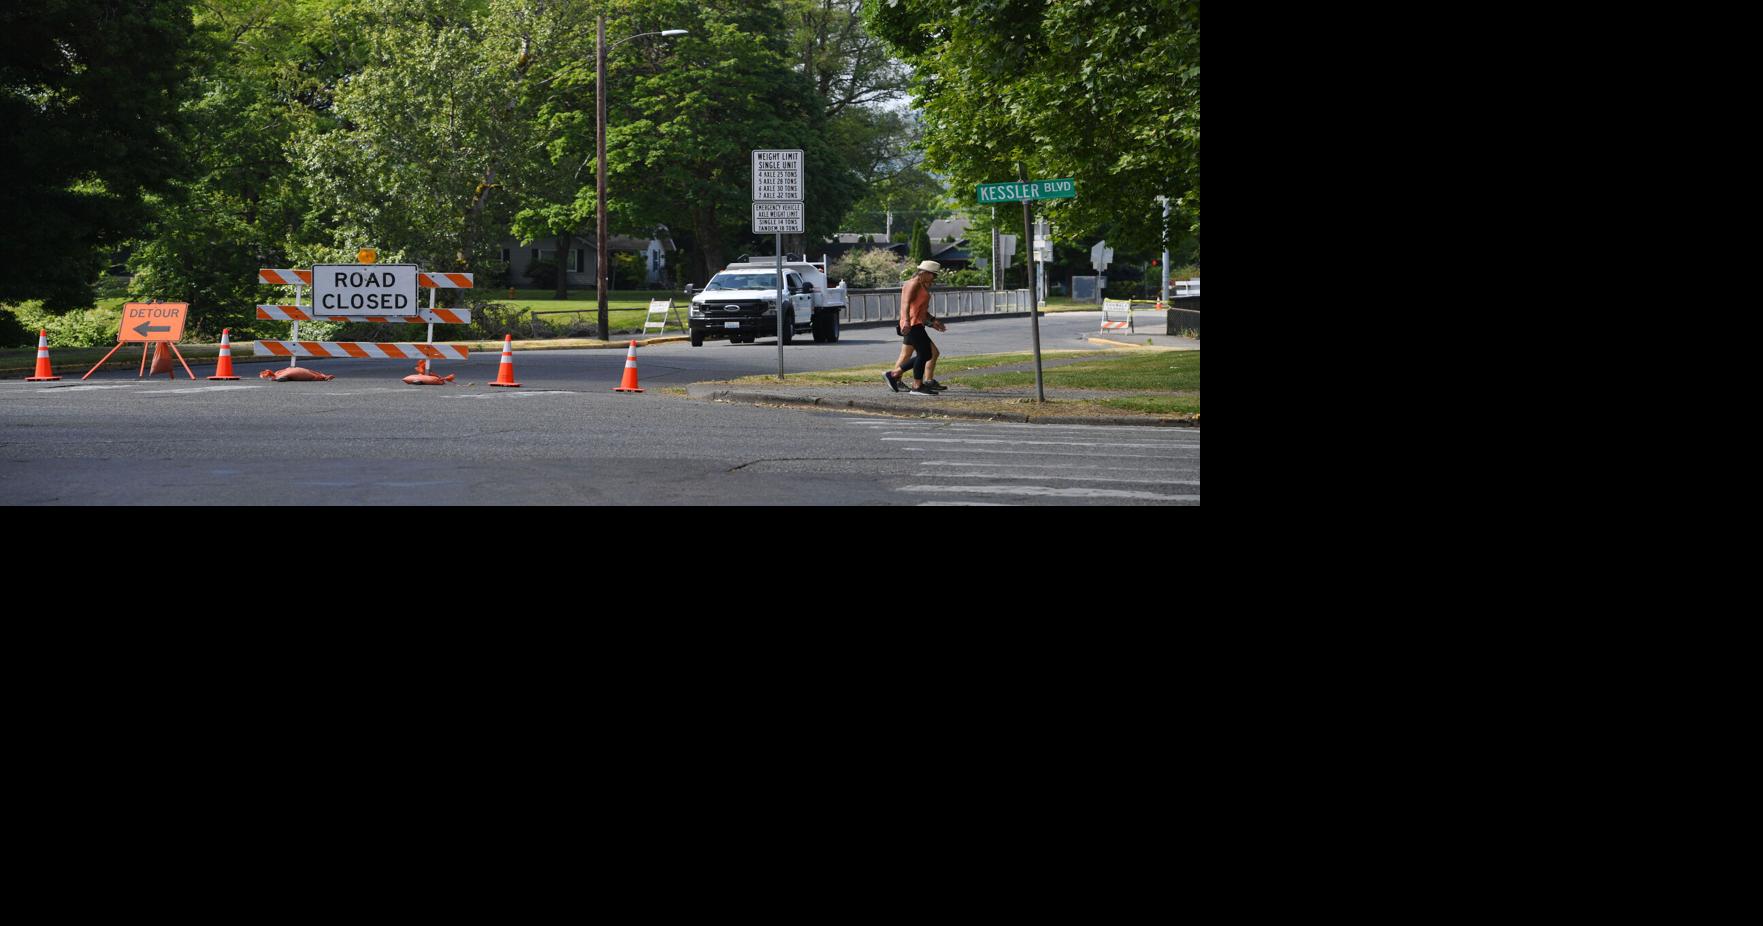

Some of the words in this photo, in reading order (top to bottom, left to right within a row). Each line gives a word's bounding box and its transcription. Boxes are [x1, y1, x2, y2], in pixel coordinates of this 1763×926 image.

[759, 161, 780, 169] SINGLE
[783, 161, 797, 169] UNIT
[980, 183, 1040, 201] KESSLER
[1044, 181, 1071, 193] BLVD
[335, 272, 396, 288] ROAD
[322, 293, 408, 310] CLOSED
[129, 308, 179, 318] DETOUR
